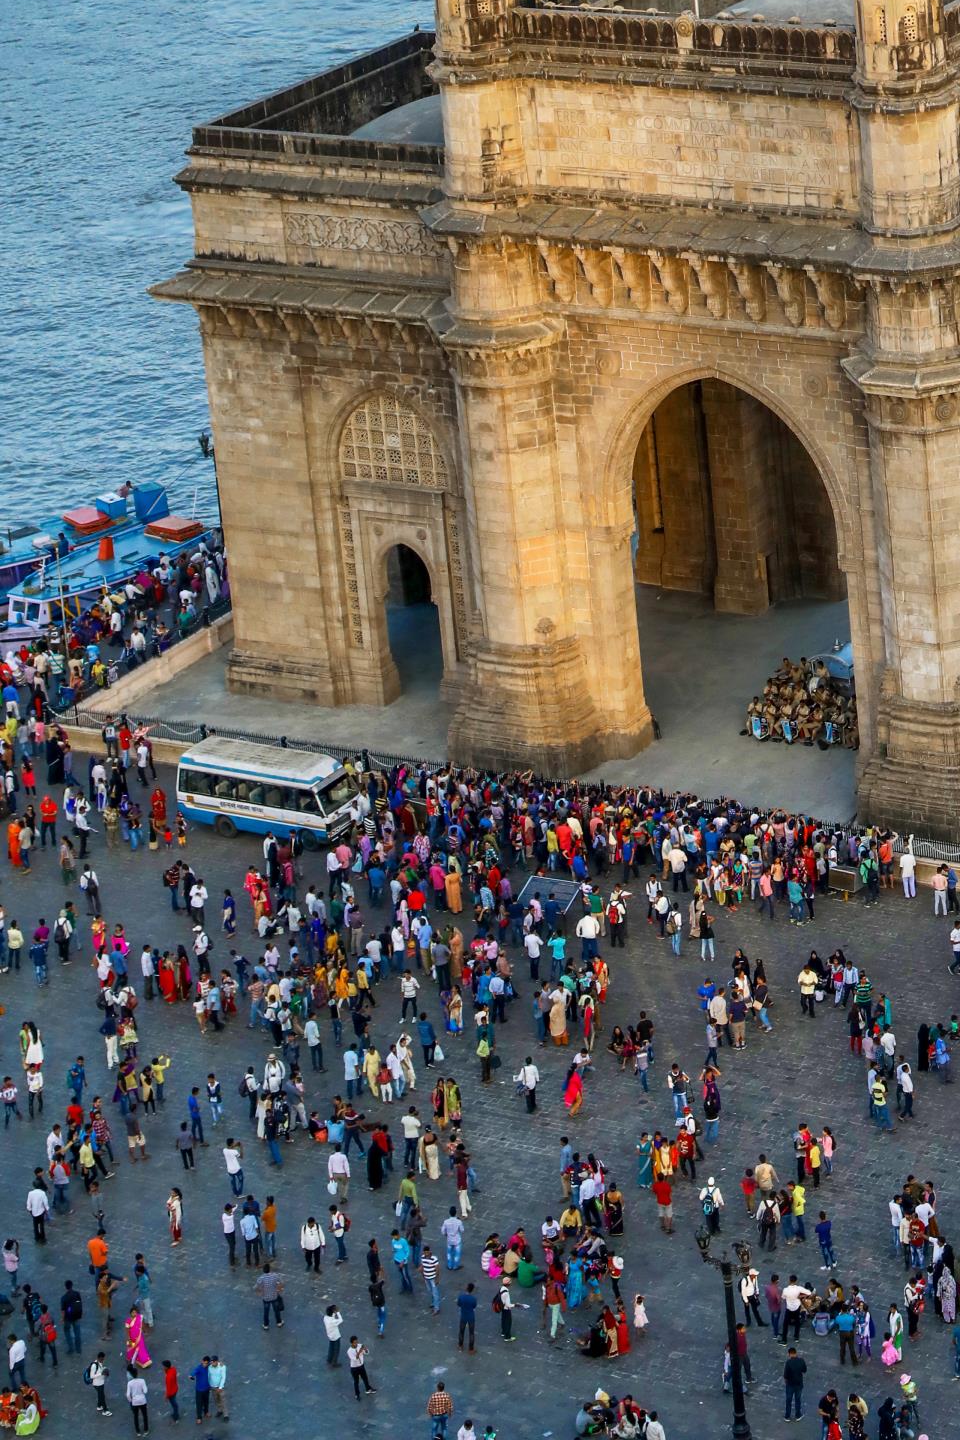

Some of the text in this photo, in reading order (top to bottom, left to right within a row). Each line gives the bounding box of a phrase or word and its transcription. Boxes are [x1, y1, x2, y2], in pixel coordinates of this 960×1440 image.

[643, 115, 742, 136] COMMEMORATE
[748, 124, 771, 138] THE
[776, 126, 832, 143] LANDING
[560, 141, 588, 152] KING
[695, 149, 718, 161] AND
[618, 158, 673, 172] SECOND
[682, 163, 699, 175] OF
[709, 164, 776, 181] DECEMBER
[786, 169, 832, 185] MCMXI
